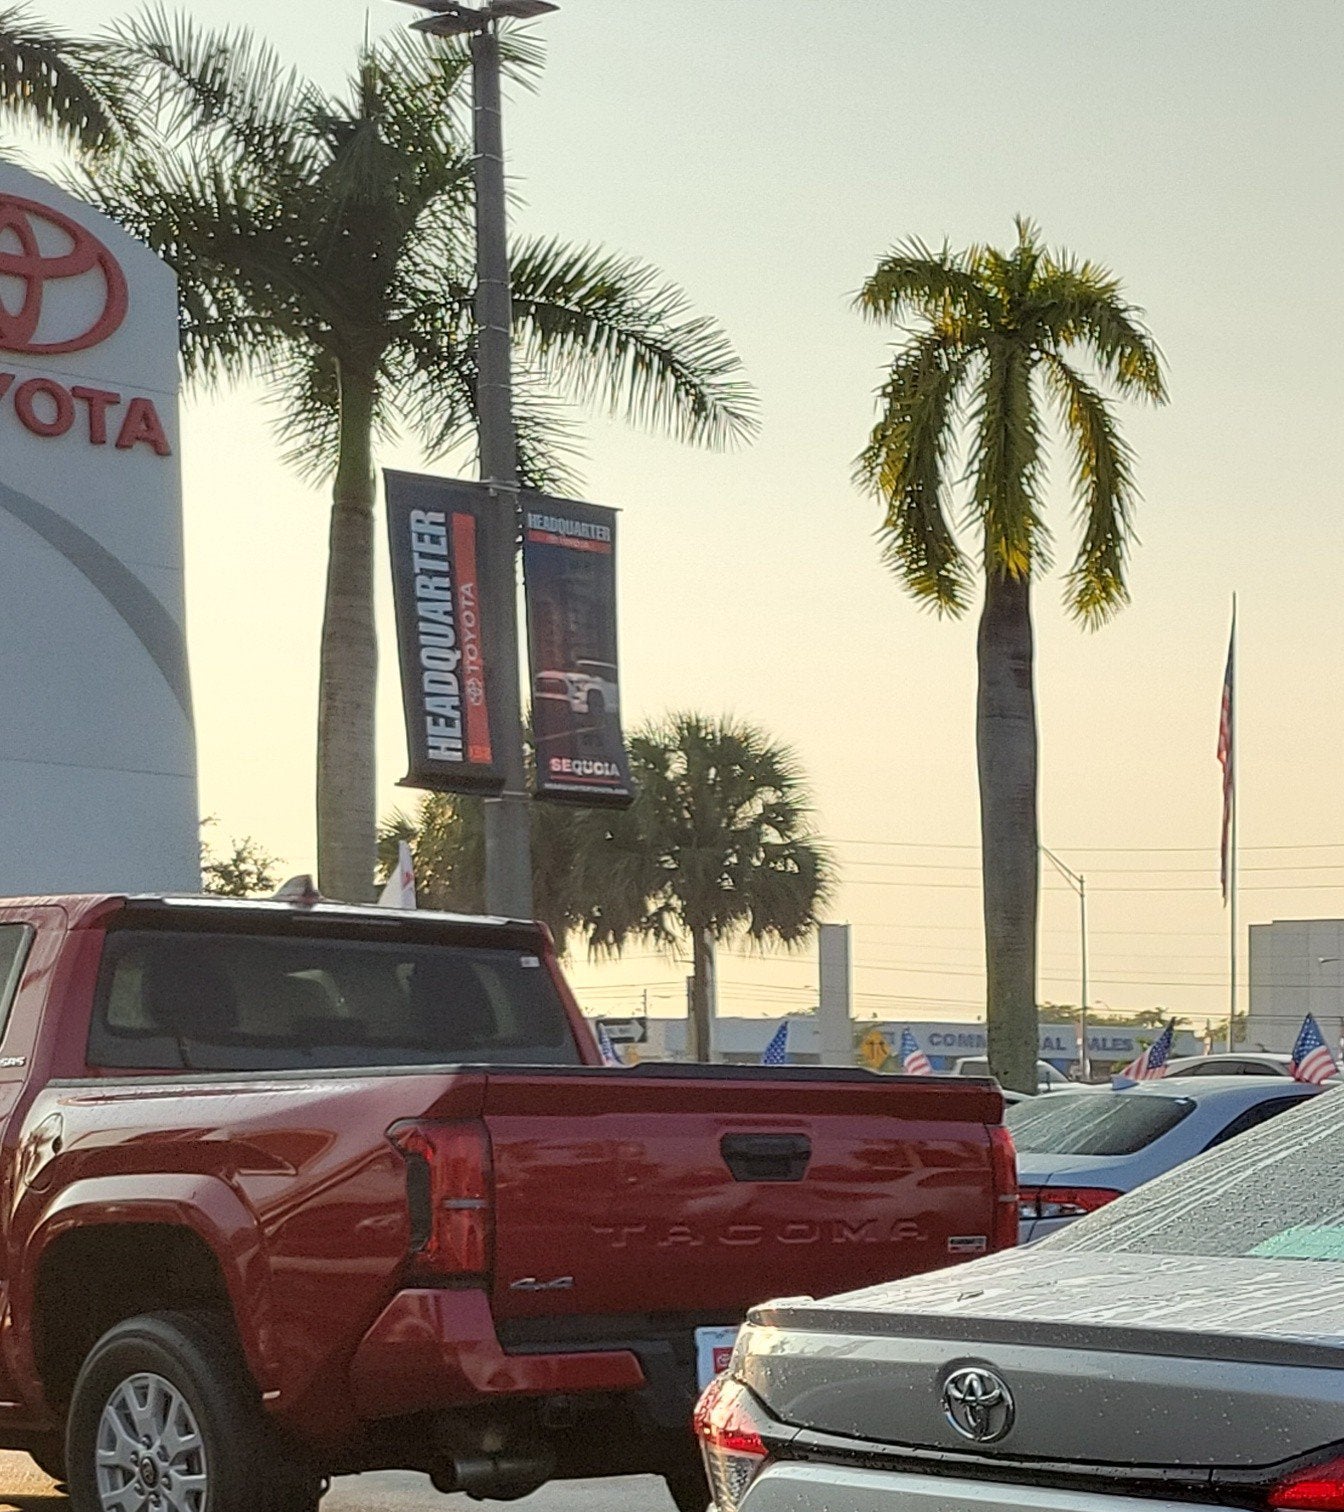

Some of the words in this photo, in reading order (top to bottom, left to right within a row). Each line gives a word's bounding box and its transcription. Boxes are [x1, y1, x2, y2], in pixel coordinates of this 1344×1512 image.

[528, 512, 611, 542] HEADQUARTER
[410, 508, 463, 762] HEADQUARTER
[460, 582, 482, 674] TOYOTA
[549, 757, 620, 777] SEQUOIA
[1079, 1036, 1135, 1051] ALES
[591, 1218, 928, 1248] TACOMA
